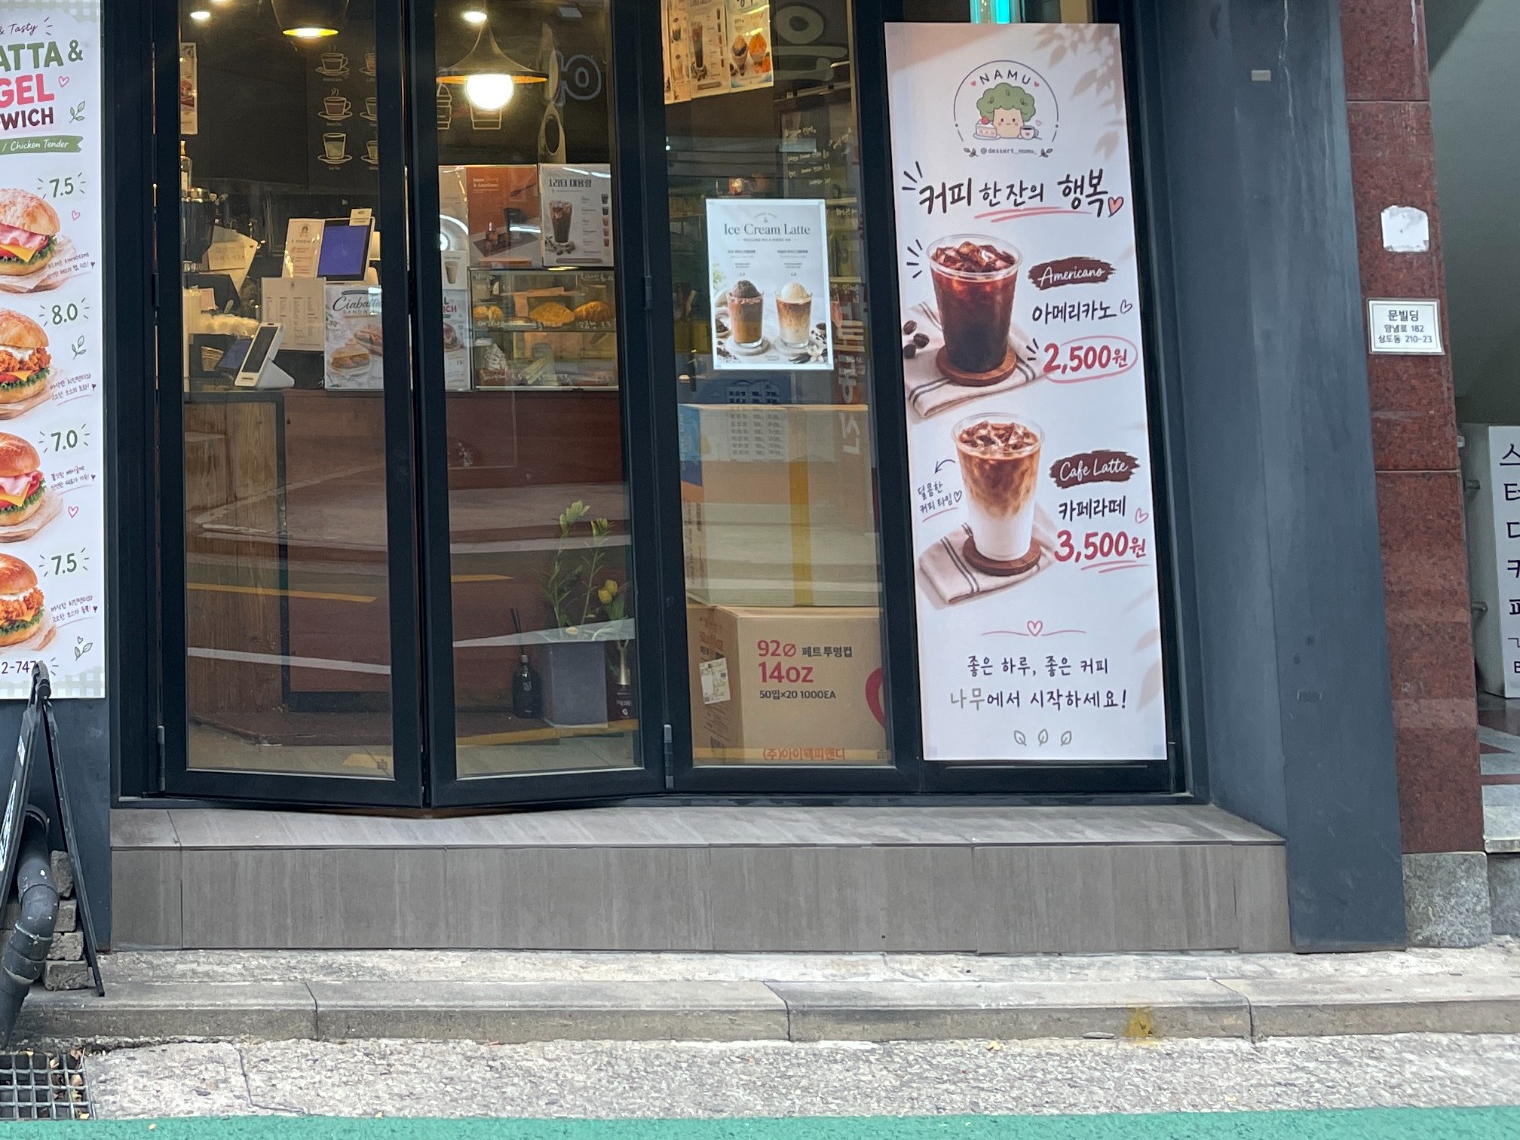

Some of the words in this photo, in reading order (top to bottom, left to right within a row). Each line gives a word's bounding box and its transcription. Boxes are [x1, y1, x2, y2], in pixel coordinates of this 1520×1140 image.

[8, 22, 38, 36] Tasty
[68, 39, 84, 61] &
[979, 69, 1031, 85] NAMU
[10, 140, 41, 150] Chicken
[43, 138, 69, 149] Tender
[49, 177, 74, 198] 7.5
[918, 177, 972, 214] 커피
[1057, 168, 1108, 218] 행복
[724, 223, 740, 235] Ice
[744, 223, 781, 235] Cream
[784, 223, 811, 235] Latte
[1038, 267, 1106, 286] Americano
[51, 303, 78, 325] 8.0
[1032, 300, 1117, 325] 아메리카노
[1388, 310, 1419, 321] 문빌딩
[1405, 335, 1433, 343] 210-23
[1043, 342, 1128, 374] 2,500원
[50, 429, 78, 452] 7.0
[1059, 461, 1090, 483] Cafe
[1093, 458, 1129, 476] Latte
[1058, 495, 1126, 522] 카페라떼
[1054, 529, 1147, 563] 3,500원
[51, 553, 77, 576] 7.5
[758, 661, 814, 683] 14oz
[967, 655, 993, 677] 좋은
[1001, 656, 1037, 677] 하루,
[1045, 655, 1072, 677] 좋은
[1080, 658, 1108, 675] 커피
[800, 690, 836, 699] 1000EA
[950, 687, 1021, 711] 나무에서
[1030, 688, 1127, 711] 시작하세요!
